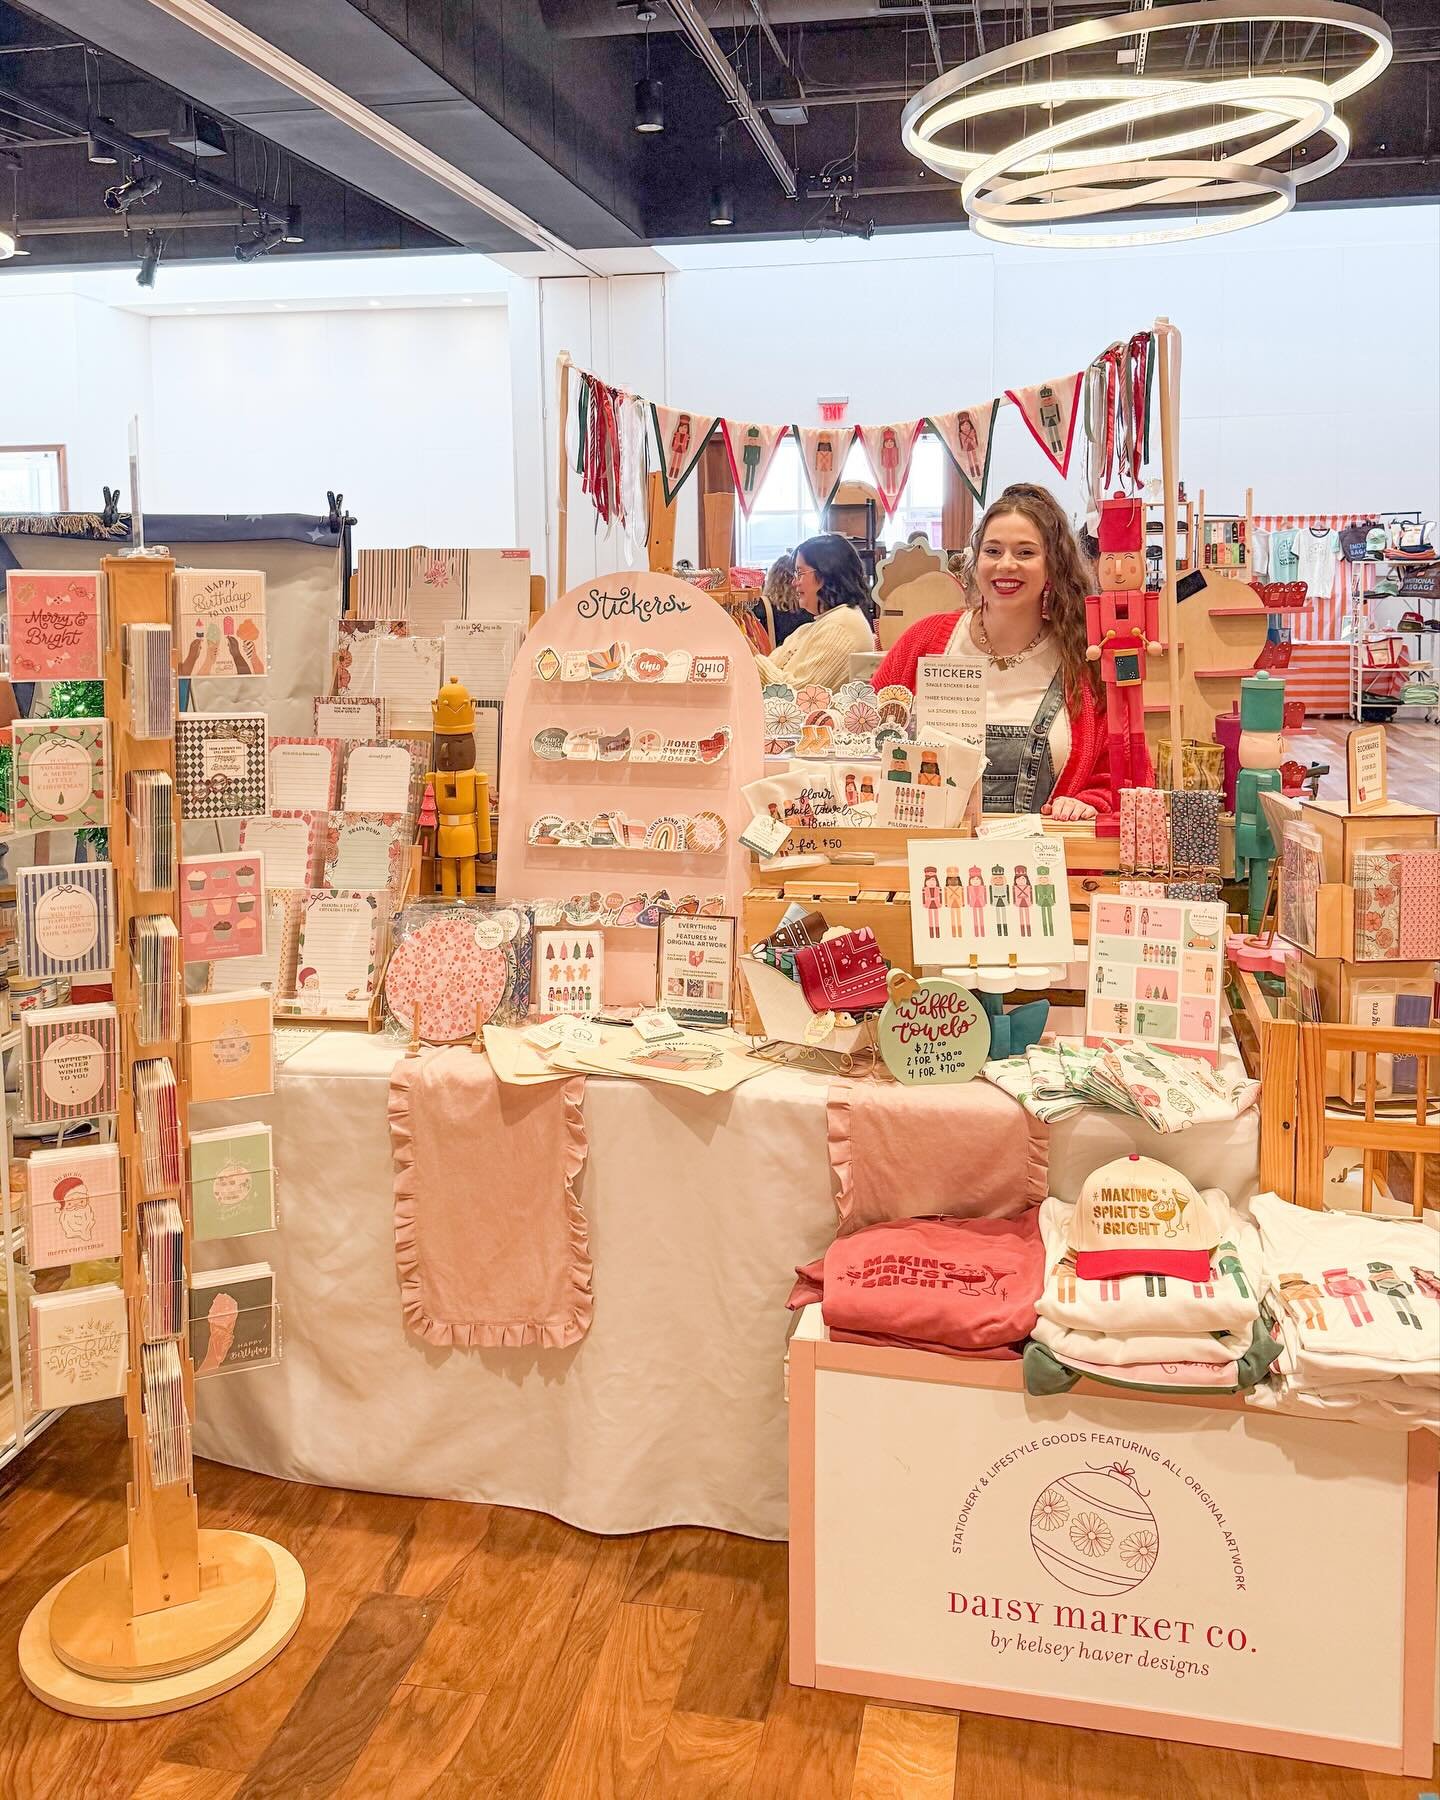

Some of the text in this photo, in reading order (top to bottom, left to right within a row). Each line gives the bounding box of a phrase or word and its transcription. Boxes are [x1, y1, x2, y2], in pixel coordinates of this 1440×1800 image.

[204, 579, 238, 593] HAPPY
[193, 589, 251, 612] Birthday
[577, 587, 688, 622] Stickers
[25, 609, 88, 629] Merry &
[26, 627, 84, 650] Bright
[696, 663, 725, 673] OHIO
[924, 668, 982, 679] STICKERS
[666, 740, 697, 748] HOME
[795, 788, 834, 804] flour
[784, 801, 852, 817] sack towels
[348, 826, 365, 835] BRAIN
[801, 818, 817, 829] $18
[787, 838, 842, 852] 3 for $50
[678, 923, 717, 931] EVERYTHING
[896, 989, 969, 1020] waffle
[892, 1014, 977, 1044] towels
[907, 1050, 962, 1066] 2 FOR $38.00
[58, 1067, 89, 1075] WISHES
[908, 1062, 965, 1079] 4 FOR $70.00
[1101, 1188, 1158, 1202] MAKING
[1093, 1205, 1150, 1219] SPIRITS
[1103, 1222, 1160, 1235] BRIGHT
[864, 1254, 956, 1270] MAKING
[846, 1264, 940, 1280] SPIRITS
[862, 1275, 954, 1289] BRIGHT
[238, 1339, 263, 1348] HAPPY
[952, 1433, 1246, 1592] STATIONERY & LIFESTYLE GOODS FEATURING ALL ORIGINAL ARTWORK
[990, 1630, 1210, 1678] by kelsey haver designs
